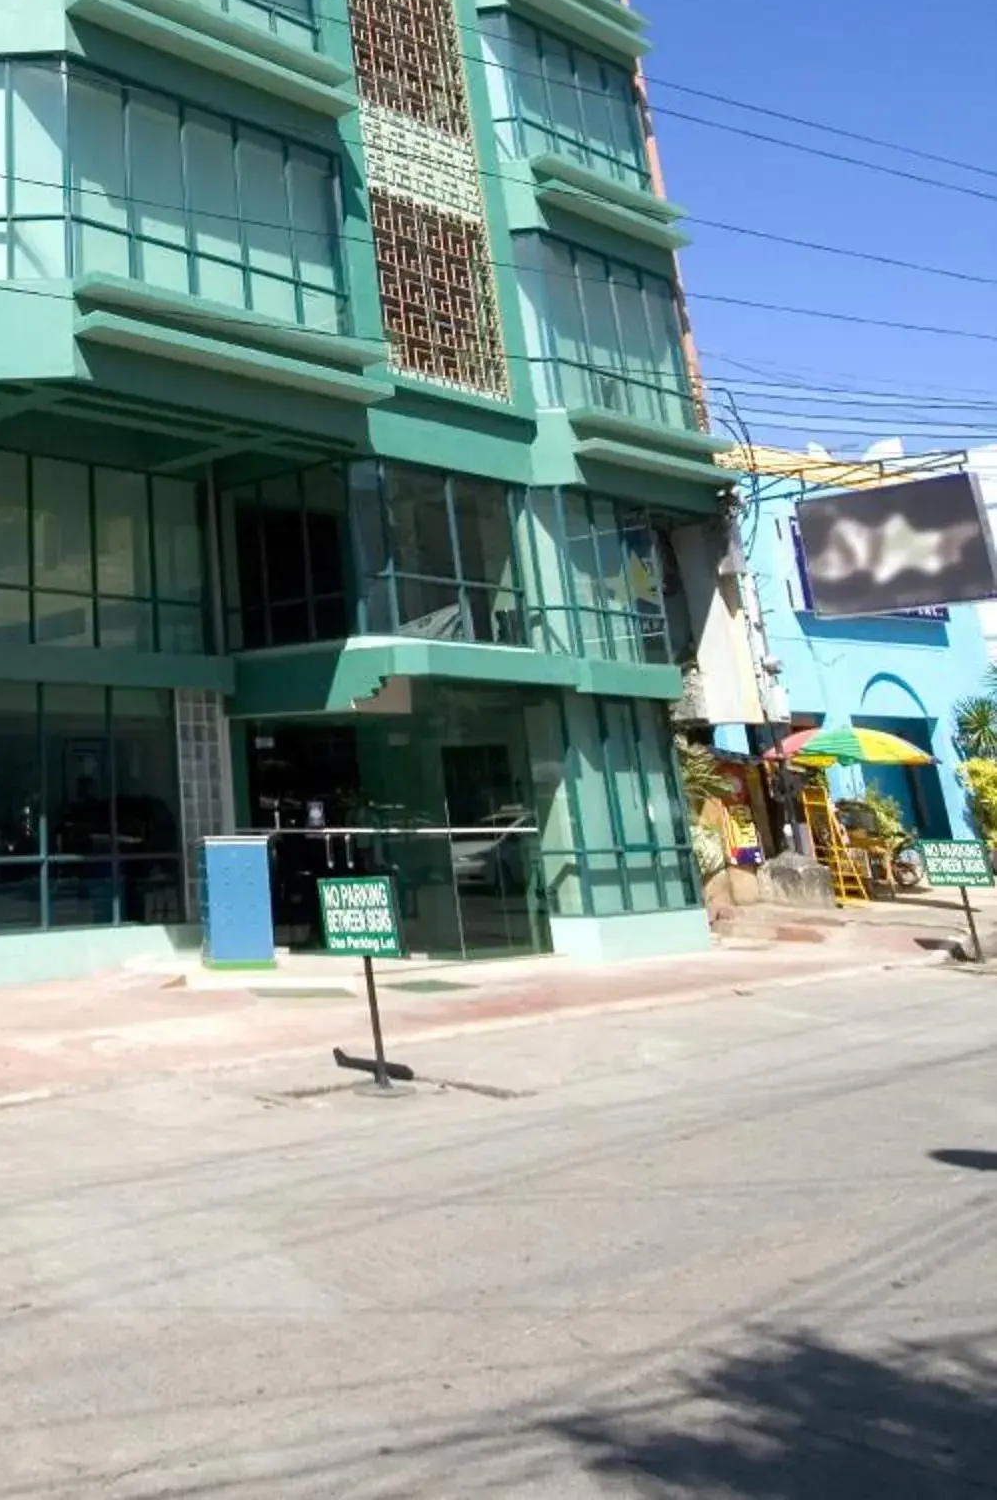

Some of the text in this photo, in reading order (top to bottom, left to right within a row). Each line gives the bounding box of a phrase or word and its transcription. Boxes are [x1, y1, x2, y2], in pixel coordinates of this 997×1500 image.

[922, 843, 982, 857] NO PARKING
[323, 882, 388, 909] NO PARKING
[327, 907, 392, 933] BETWEEN SIGNS
[347, 935, 379, 952] Parking
[380, 936, 396, 949] Lot
